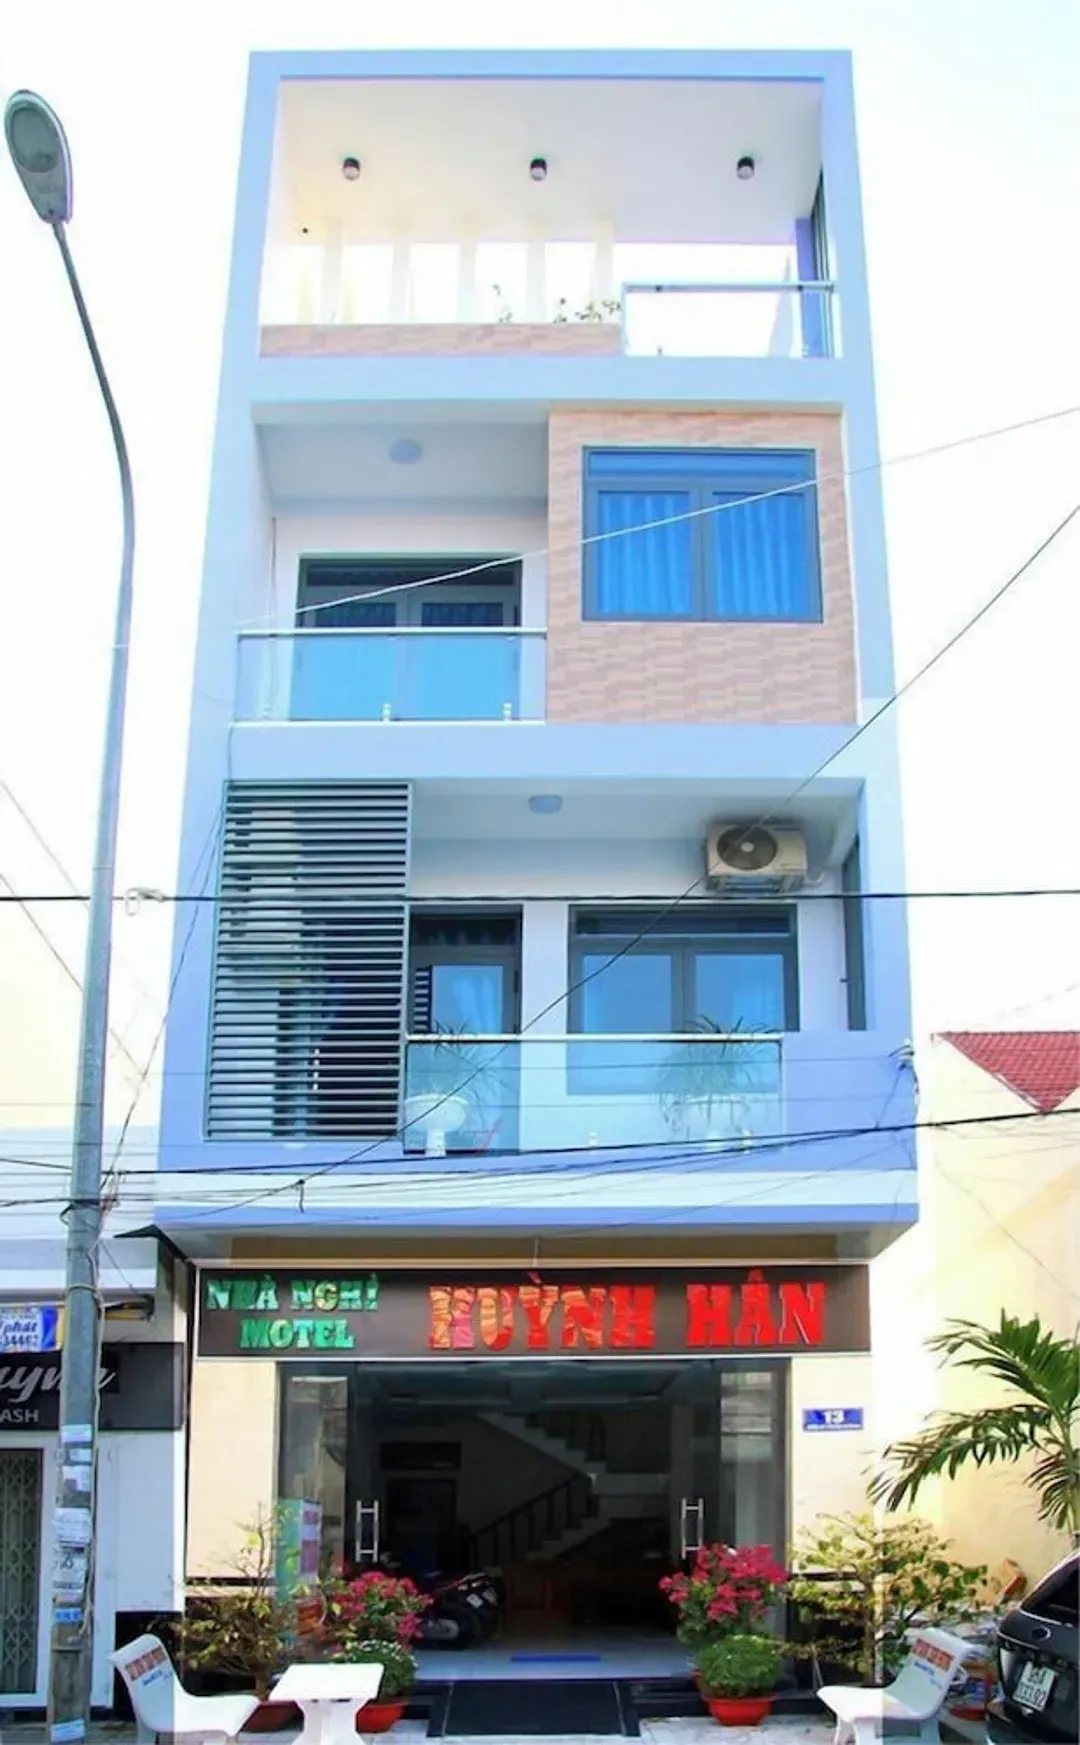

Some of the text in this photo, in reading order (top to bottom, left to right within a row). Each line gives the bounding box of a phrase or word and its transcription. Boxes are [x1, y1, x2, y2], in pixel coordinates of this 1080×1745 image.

[206, 1272, 378, 1310] NHÀ NGHỈ
[428, 1268, 825, 1349] HUỲNH HÂN
[239, 1318, 355, 1348] MOTEL
